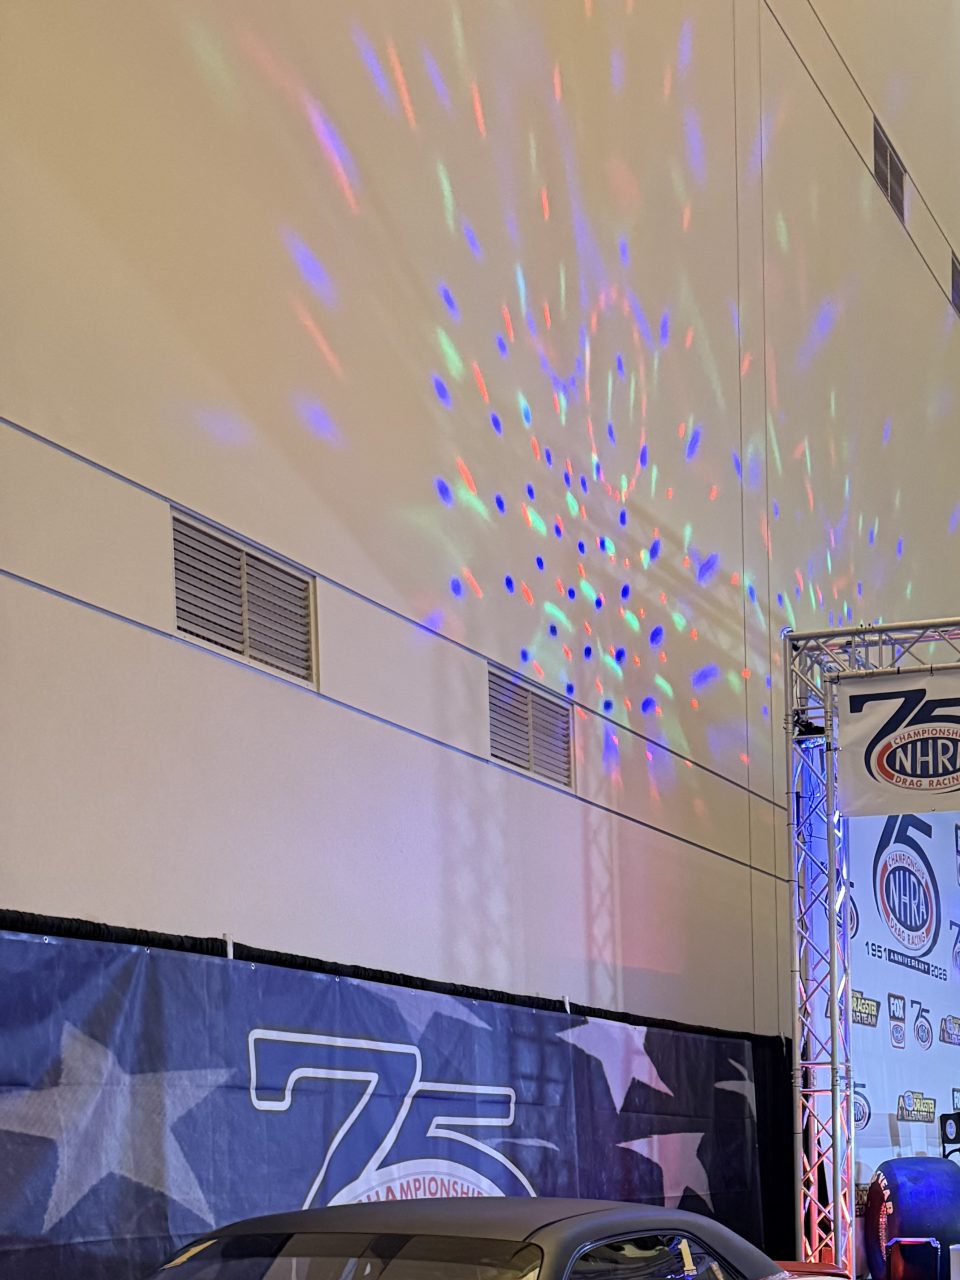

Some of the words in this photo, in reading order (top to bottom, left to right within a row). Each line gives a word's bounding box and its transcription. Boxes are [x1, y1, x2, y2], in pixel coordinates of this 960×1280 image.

[894, 775, 923, 788] DRAG
[889, 871, 927, 927] NHRA
[890, 916, 906, 942] DRAG
[865, 941, 888, 961] 1951
[852, 997, 877, 1015] RAGSTER
[890, 996, 904, 1018] FOX
